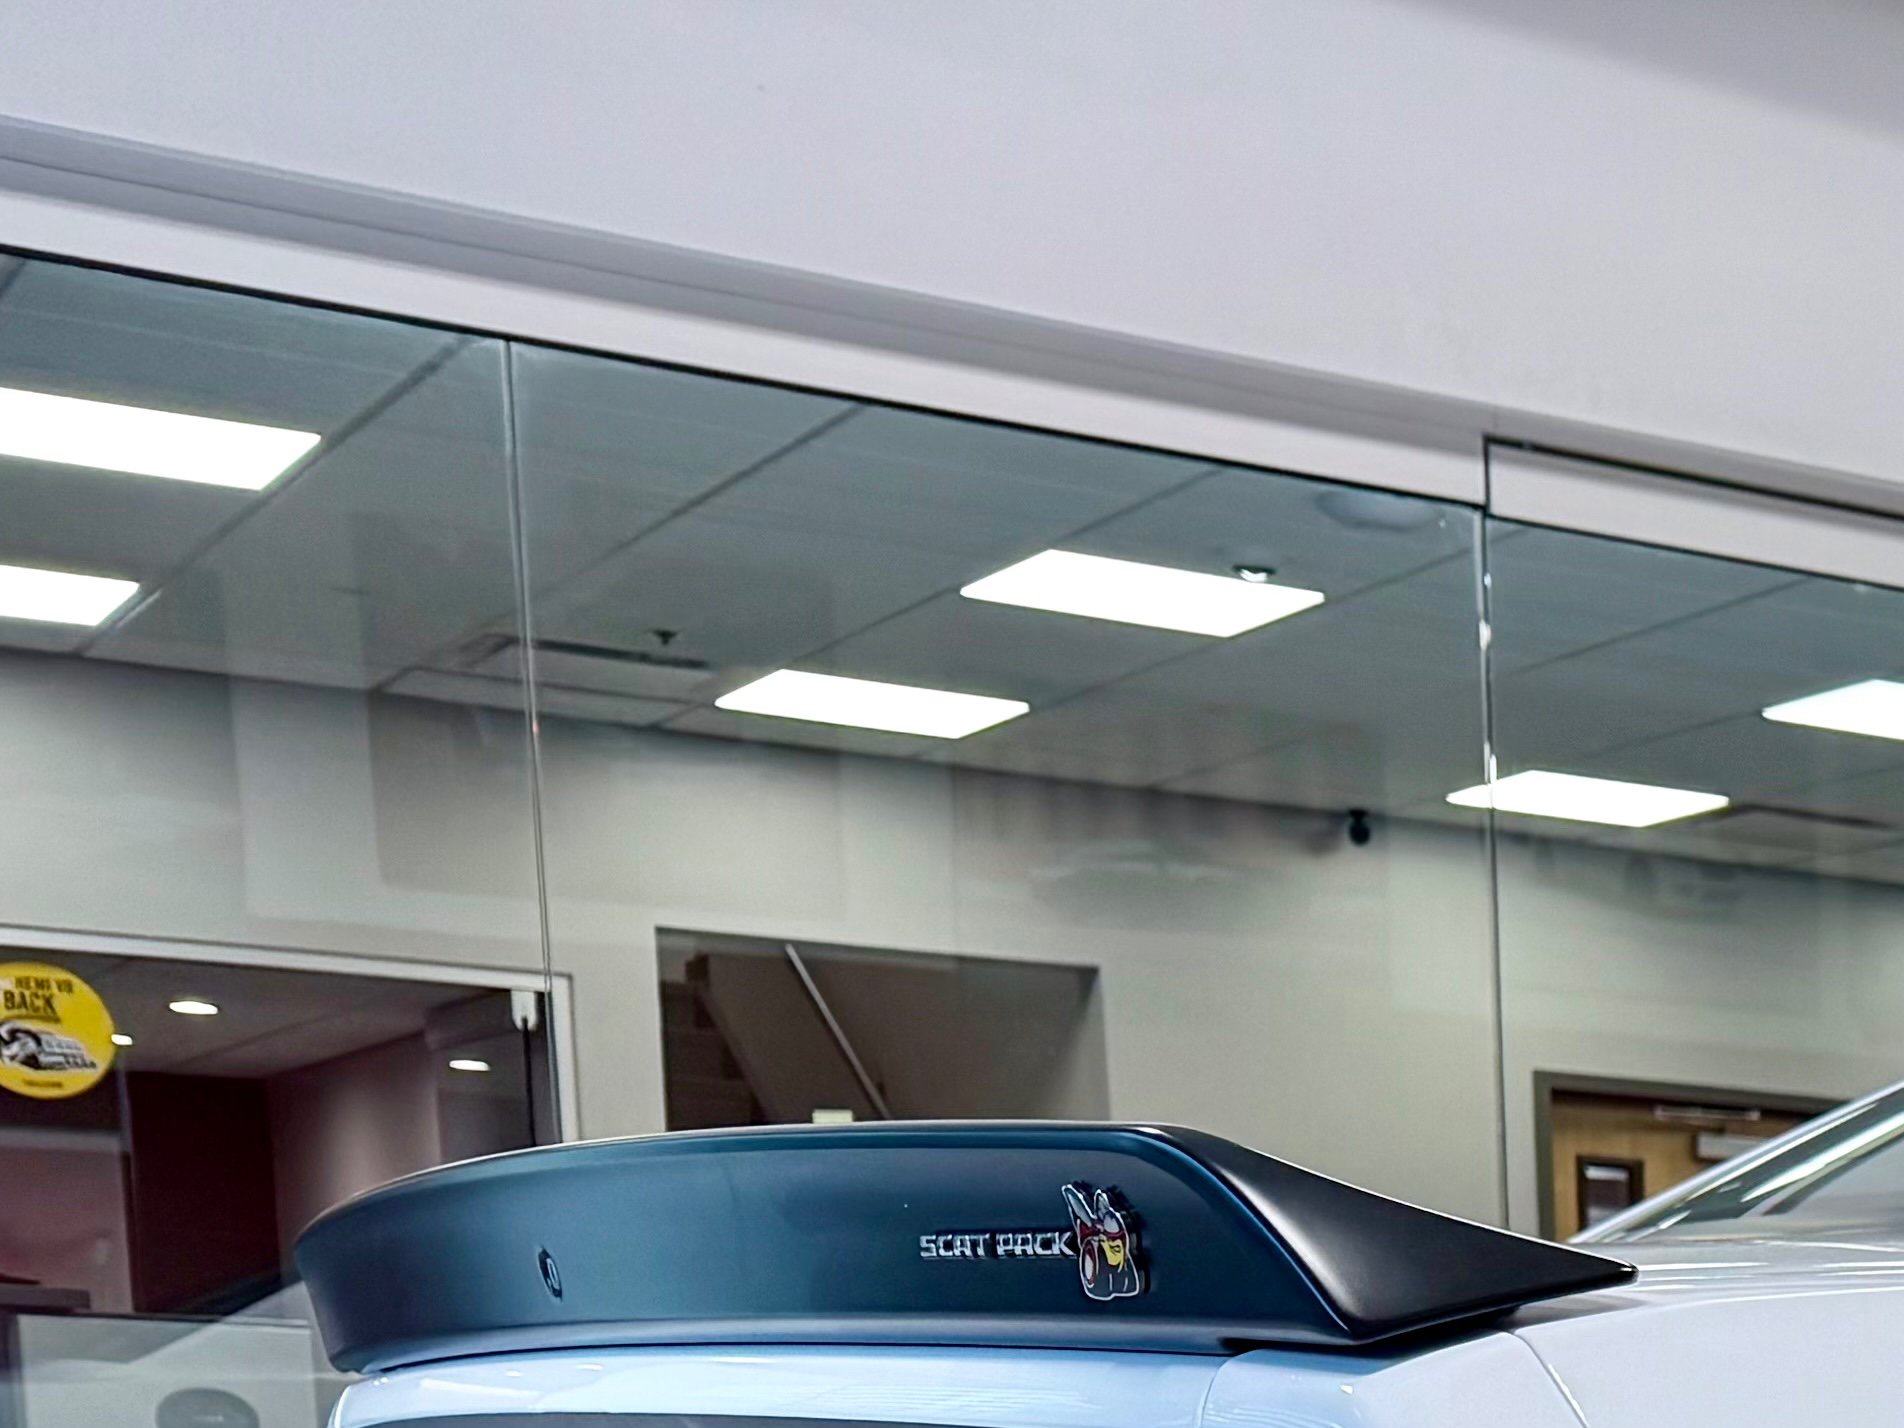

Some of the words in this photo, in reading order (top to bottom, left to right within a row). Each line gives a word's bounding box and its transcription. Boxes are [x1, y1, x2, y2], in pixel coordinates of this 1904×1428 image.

[3, 990, 59, 1016] BACK
[919, 1233, 990, 1258] SCAT
[995, 1231, 1076, 1258] PACK
